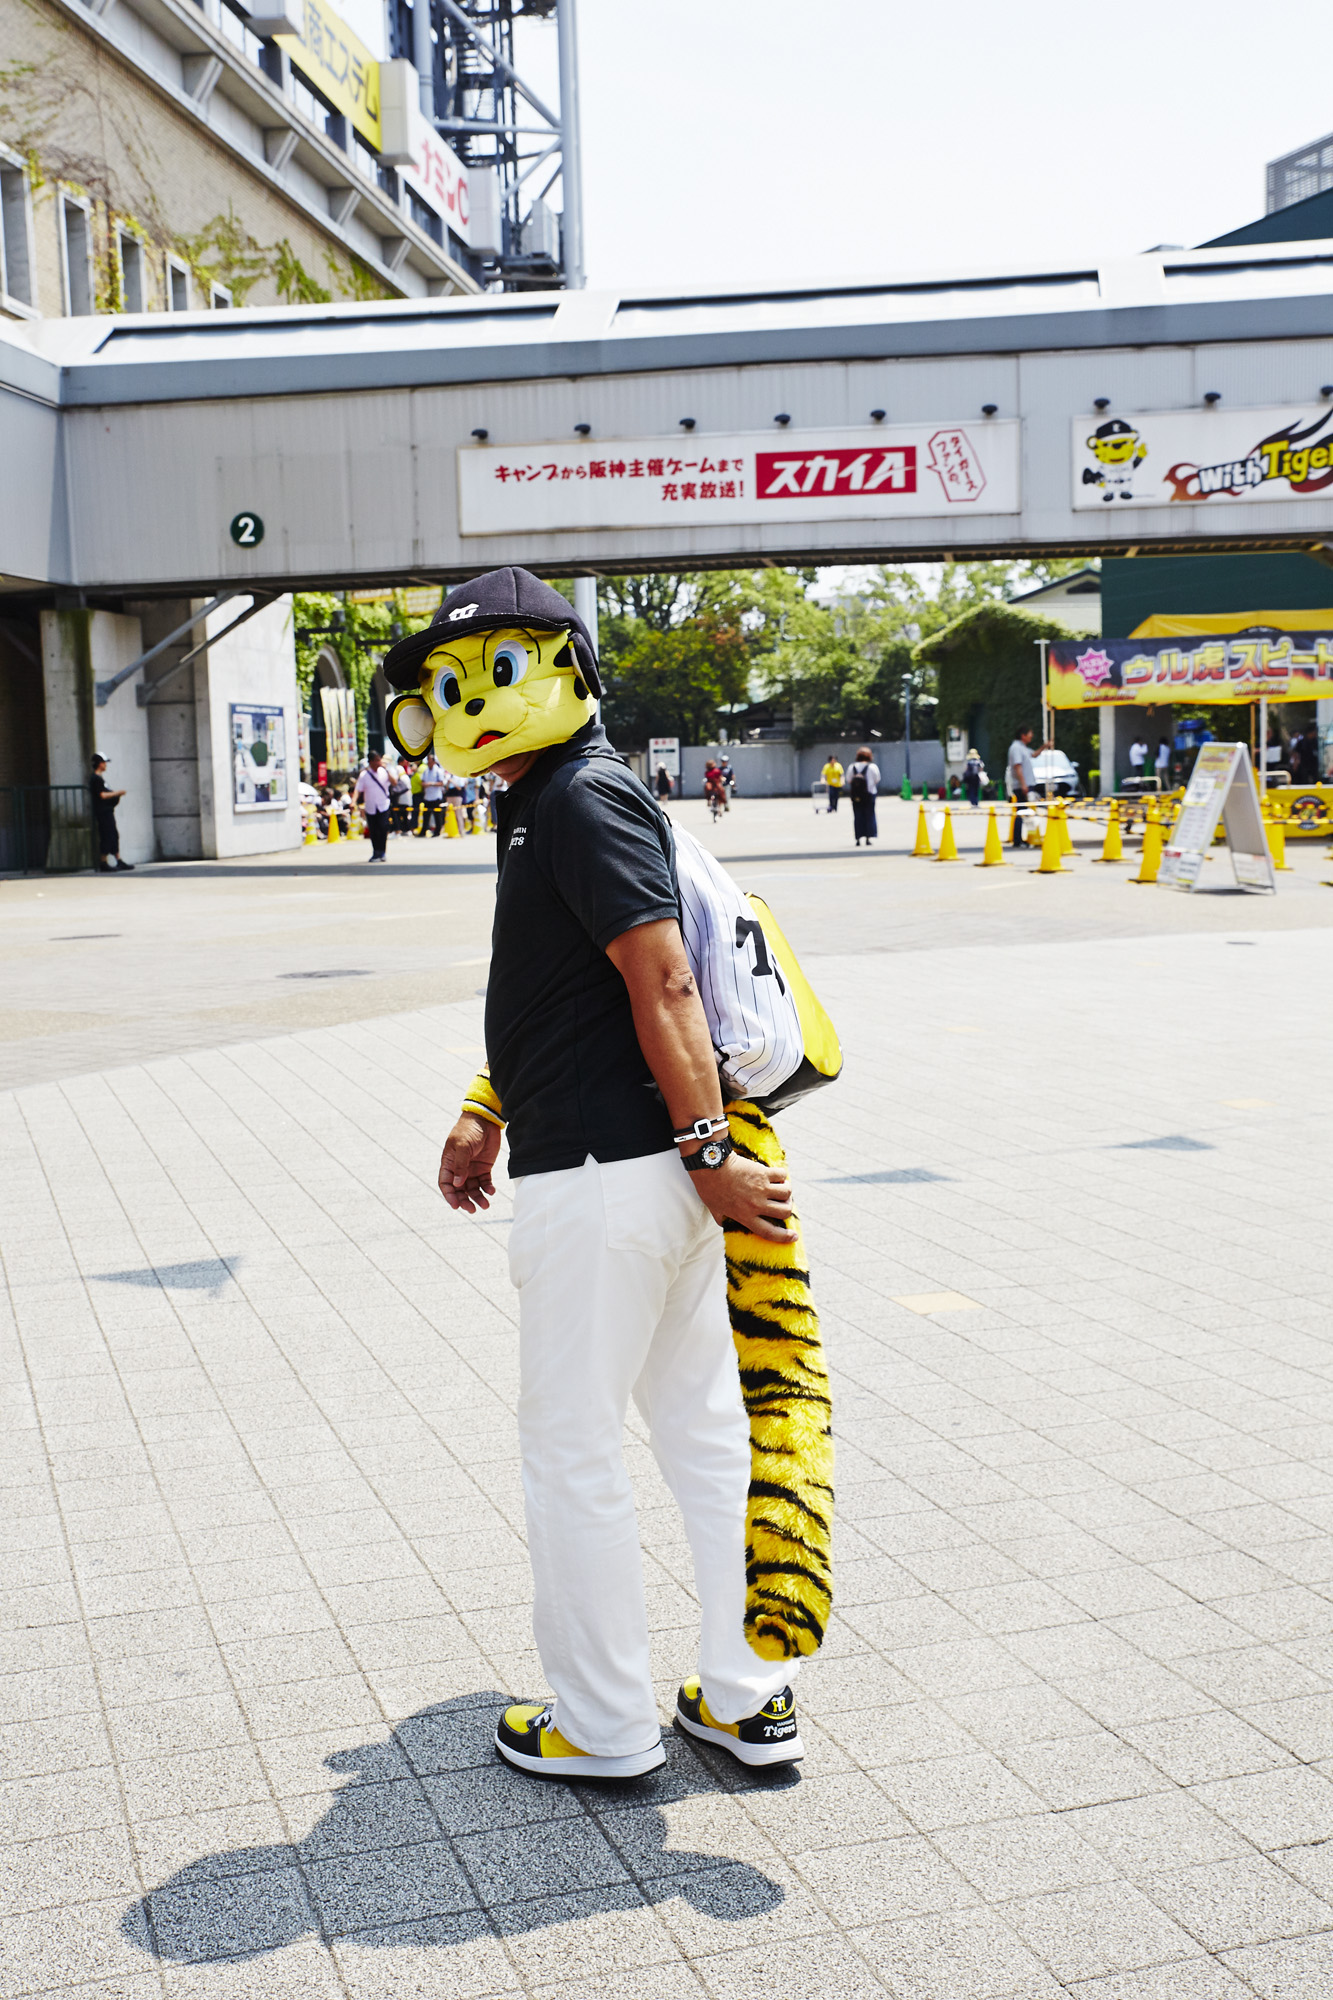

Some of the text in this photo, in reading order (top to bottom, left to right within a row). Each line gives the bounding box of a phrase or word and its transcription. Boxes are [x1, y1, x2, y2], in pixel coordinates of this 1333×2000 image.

[494, 457, 744, 482] キャンプから阪神主催ゲームまで
[765, 452, 914, 495] スカイA
[950, 435, 978, 492] タイガース
[1199, 455, 1264, 493] With
[238, 516, 255, 542] 2
[763, 1723, 796, 1738] Tigers
